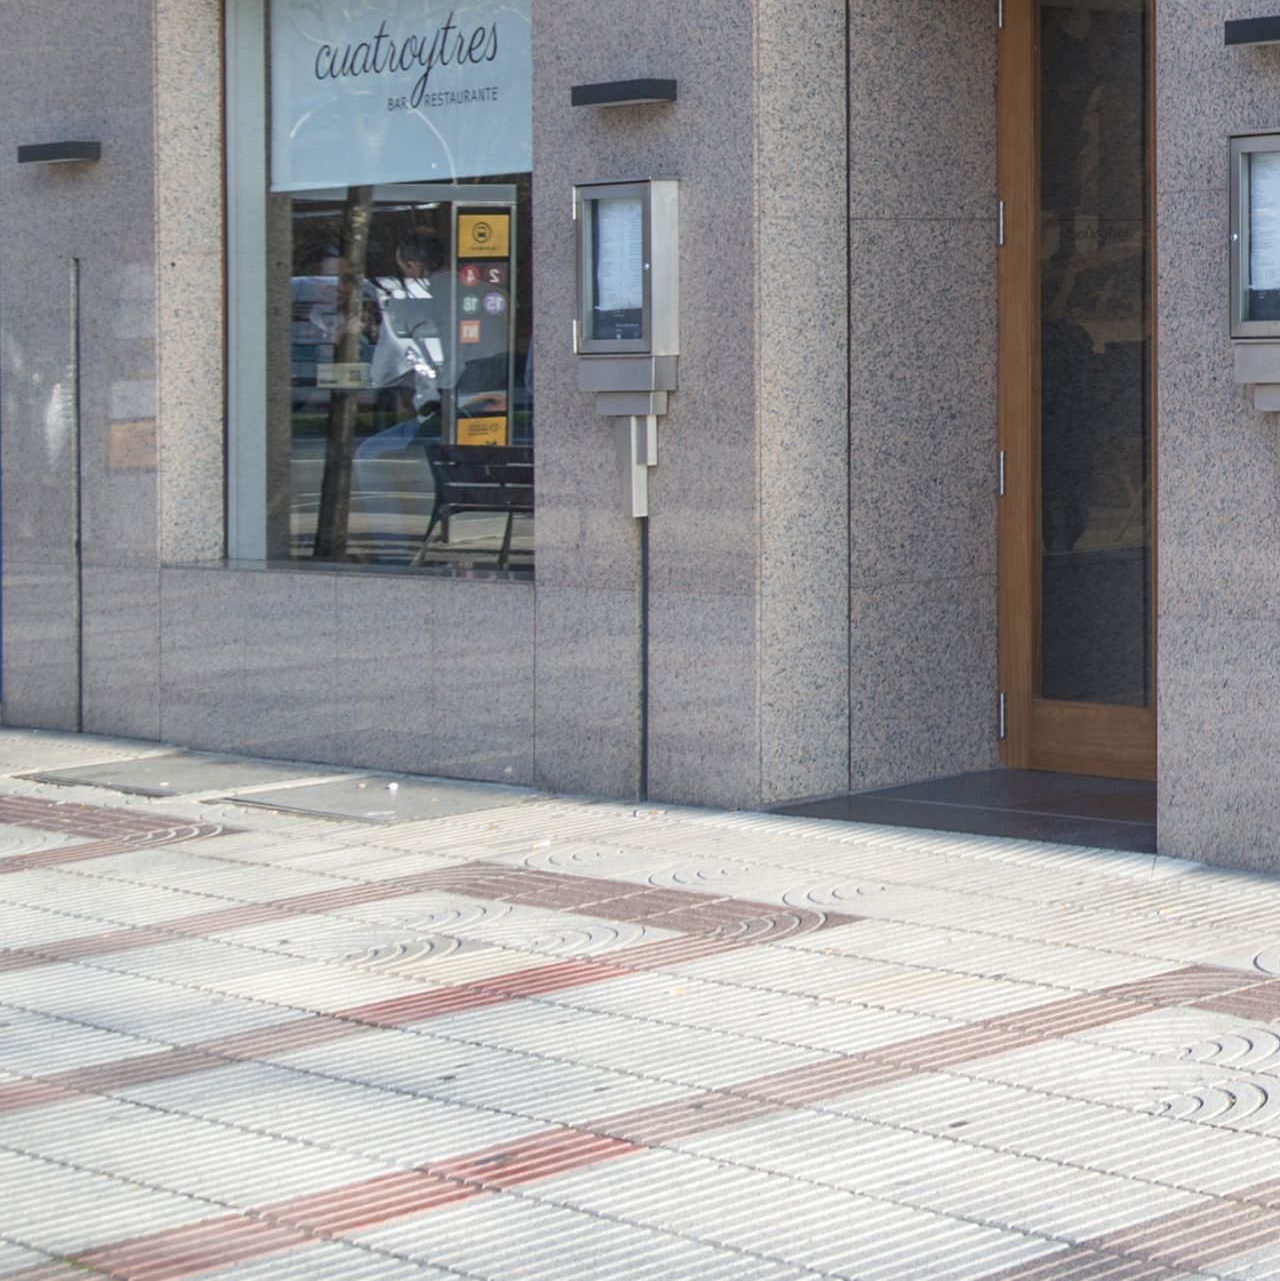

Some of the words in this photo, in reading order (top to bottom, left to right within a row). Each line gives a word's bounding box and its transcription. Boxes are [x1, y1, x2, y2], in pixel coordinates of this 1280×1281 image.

[315, 11, 497, 108] cuatroytres
[387, 97, 407, 111] BAR
[424, 87, 498, 107] RESTAURANTE
